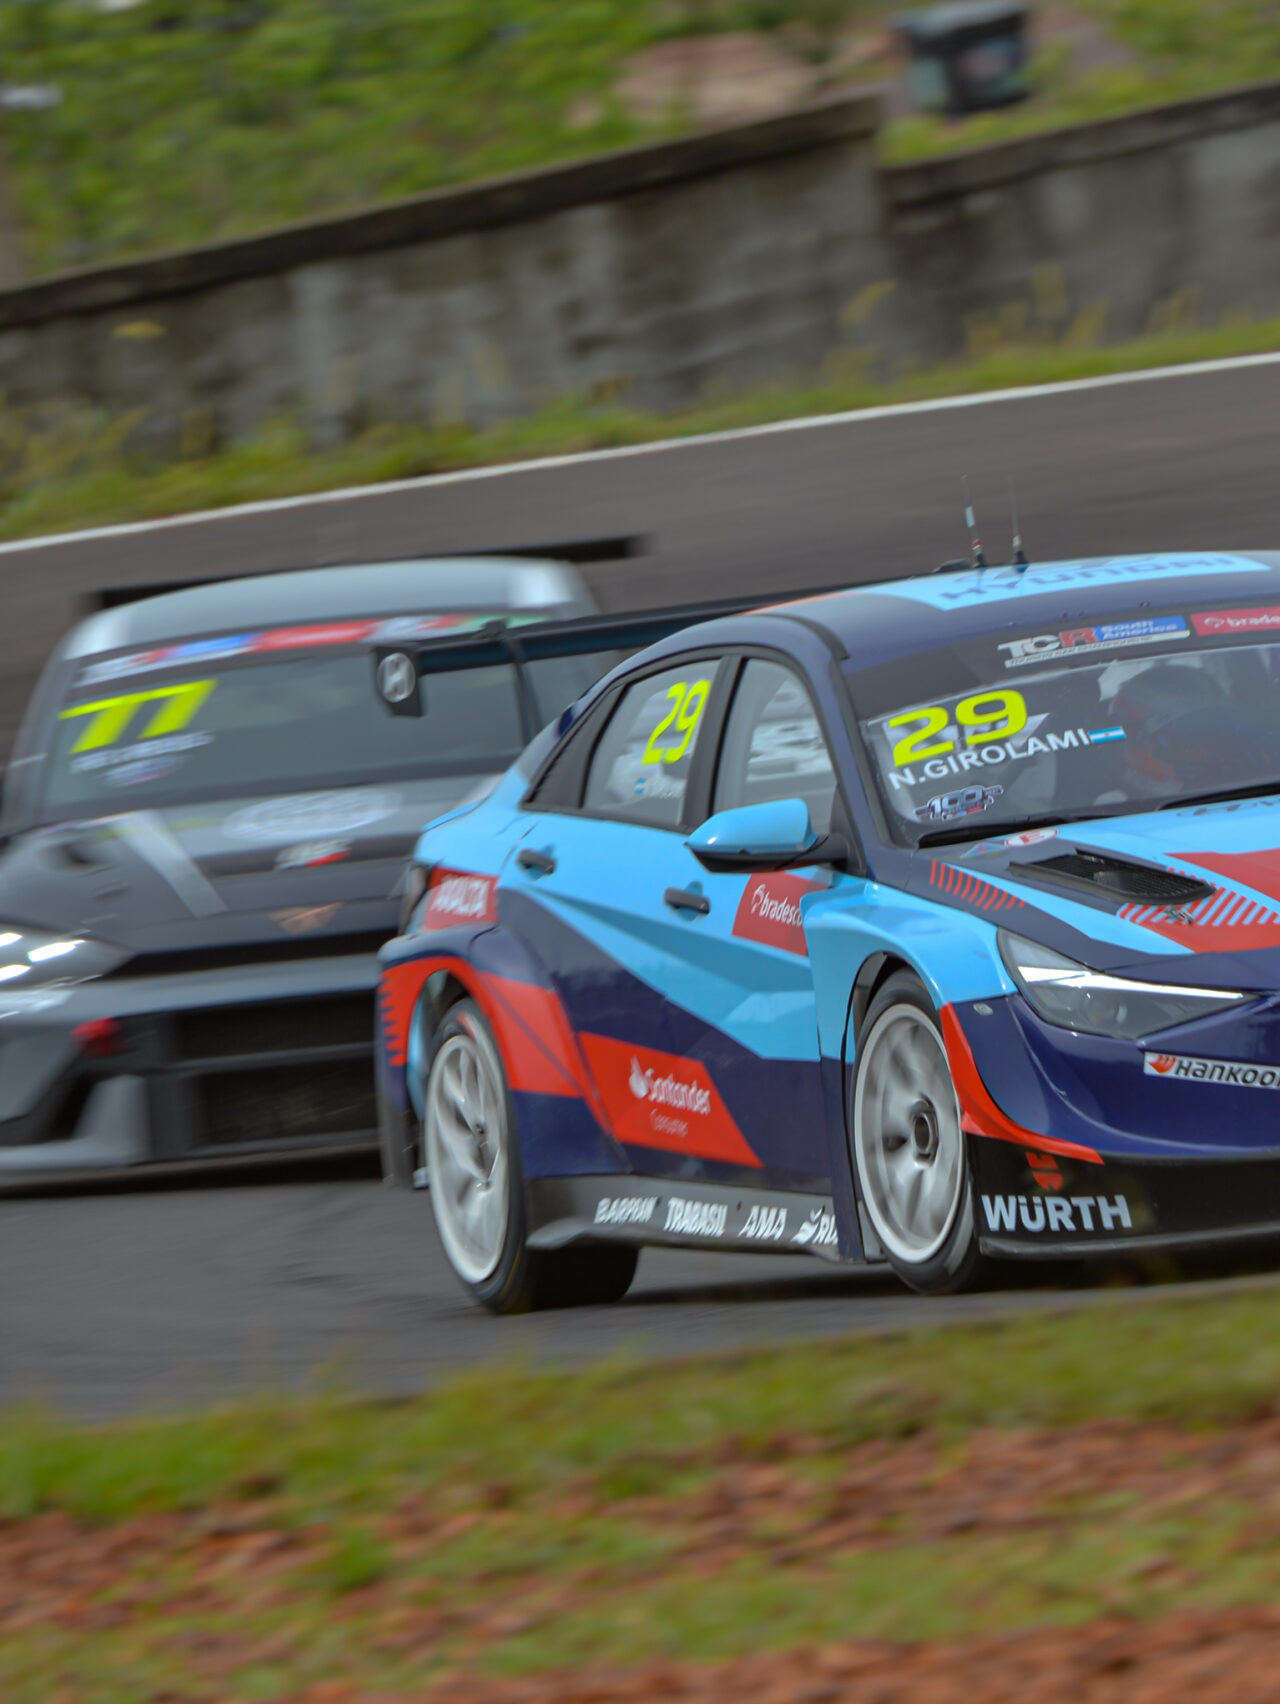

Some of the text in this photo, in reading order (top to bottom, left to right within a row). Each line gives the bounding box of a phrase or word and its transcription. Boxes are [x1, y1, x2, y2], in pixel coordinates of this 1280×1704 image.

[998, 627, 1098, 659] TCR
[1101, 620, 1153, 633] South
[1103, 624, 1178, 640] America
[58, 679, 218, 754] 77
[641, 680, 711, 766] 29
[889, 690, 1028, 767] 29
[888, 728, 1090, 791] N.GIROLAMI
[759, 891, 803, 927] bradesco
[738, 1205, 788, 1241] AMA
[981, 1194, 1133, 1232] WÜRTH
